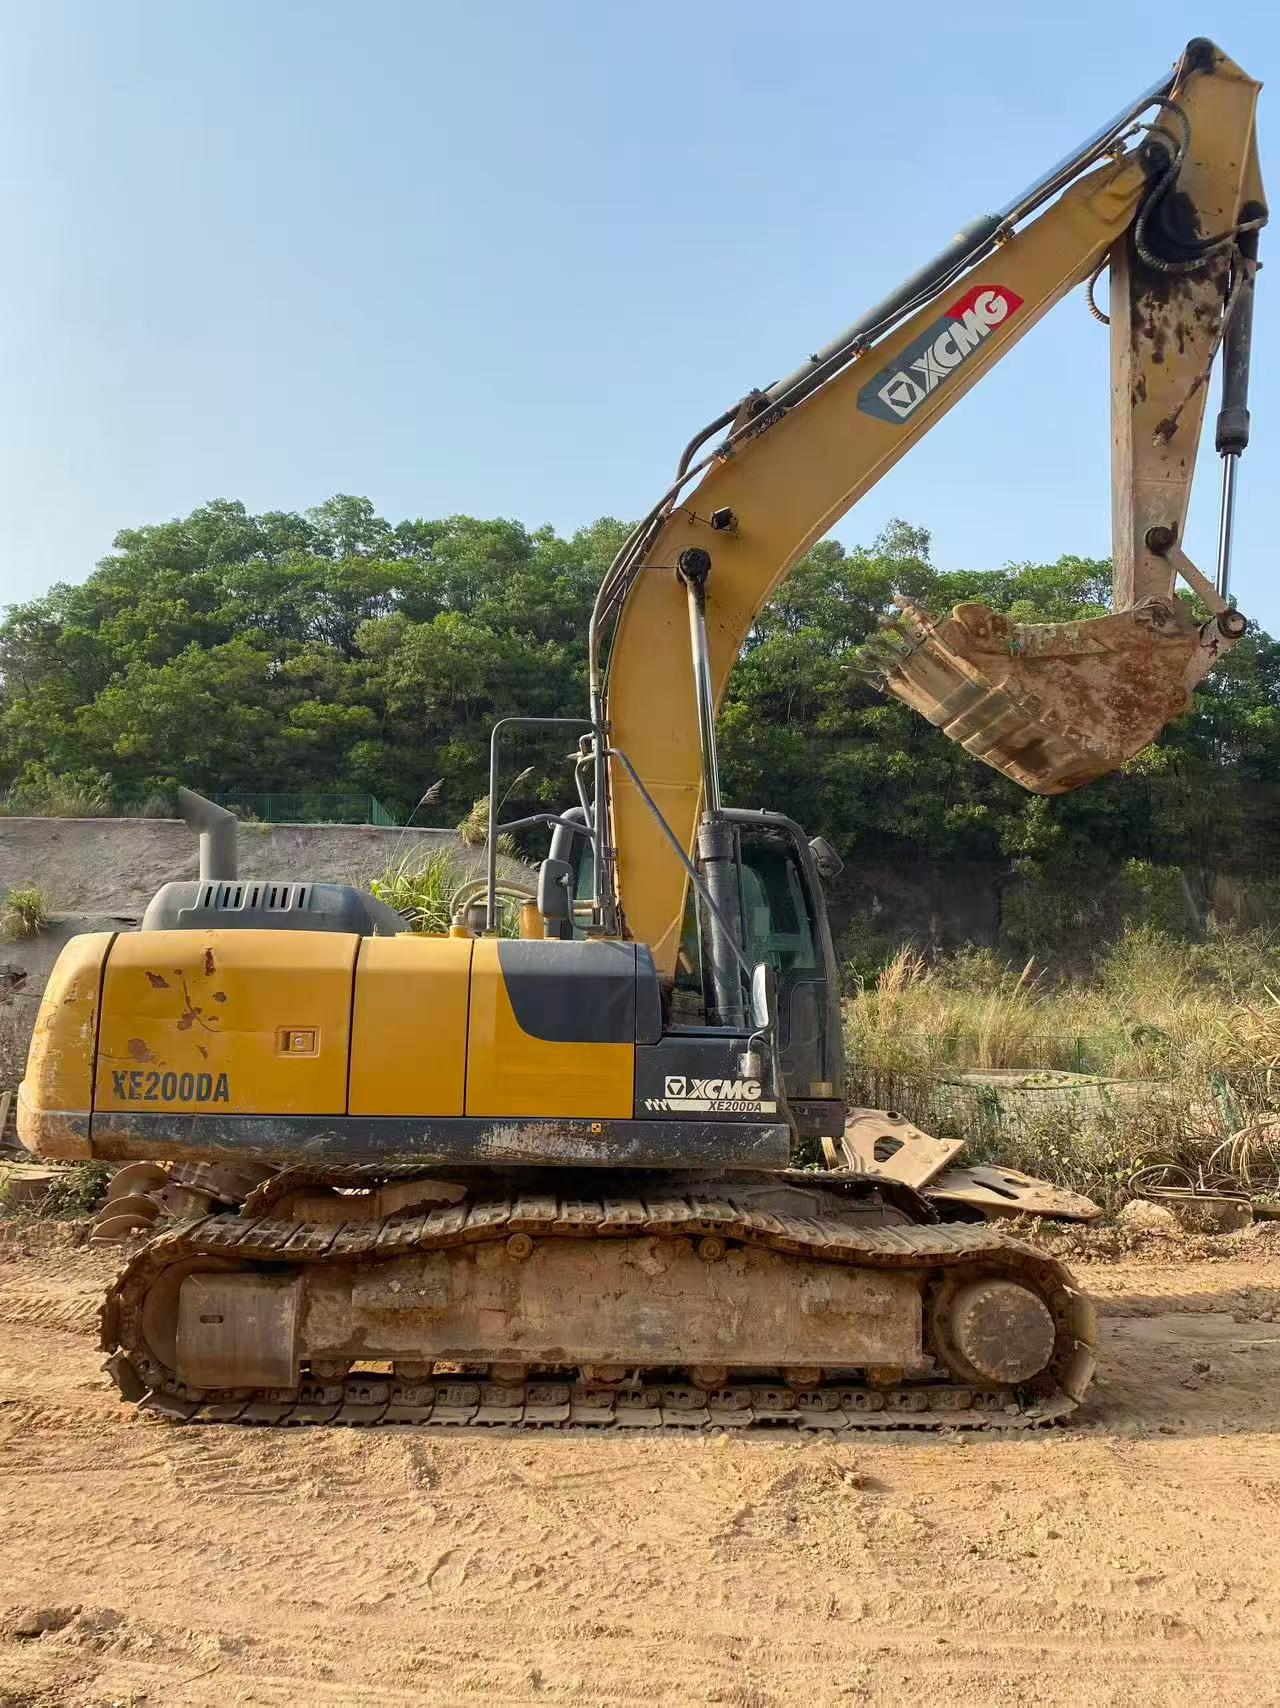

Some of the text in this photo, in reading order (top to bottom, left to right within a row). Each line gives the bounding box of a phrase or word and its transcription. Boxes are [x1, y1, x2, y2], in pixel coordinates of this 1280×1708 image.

[909, 291, 1008, 394] XCMG
[112, 1070, 230, 1102] XE200DA
[686, 1079, 761, 1100] XCMG
[708, 1101, 762, 1112] XE200DA
